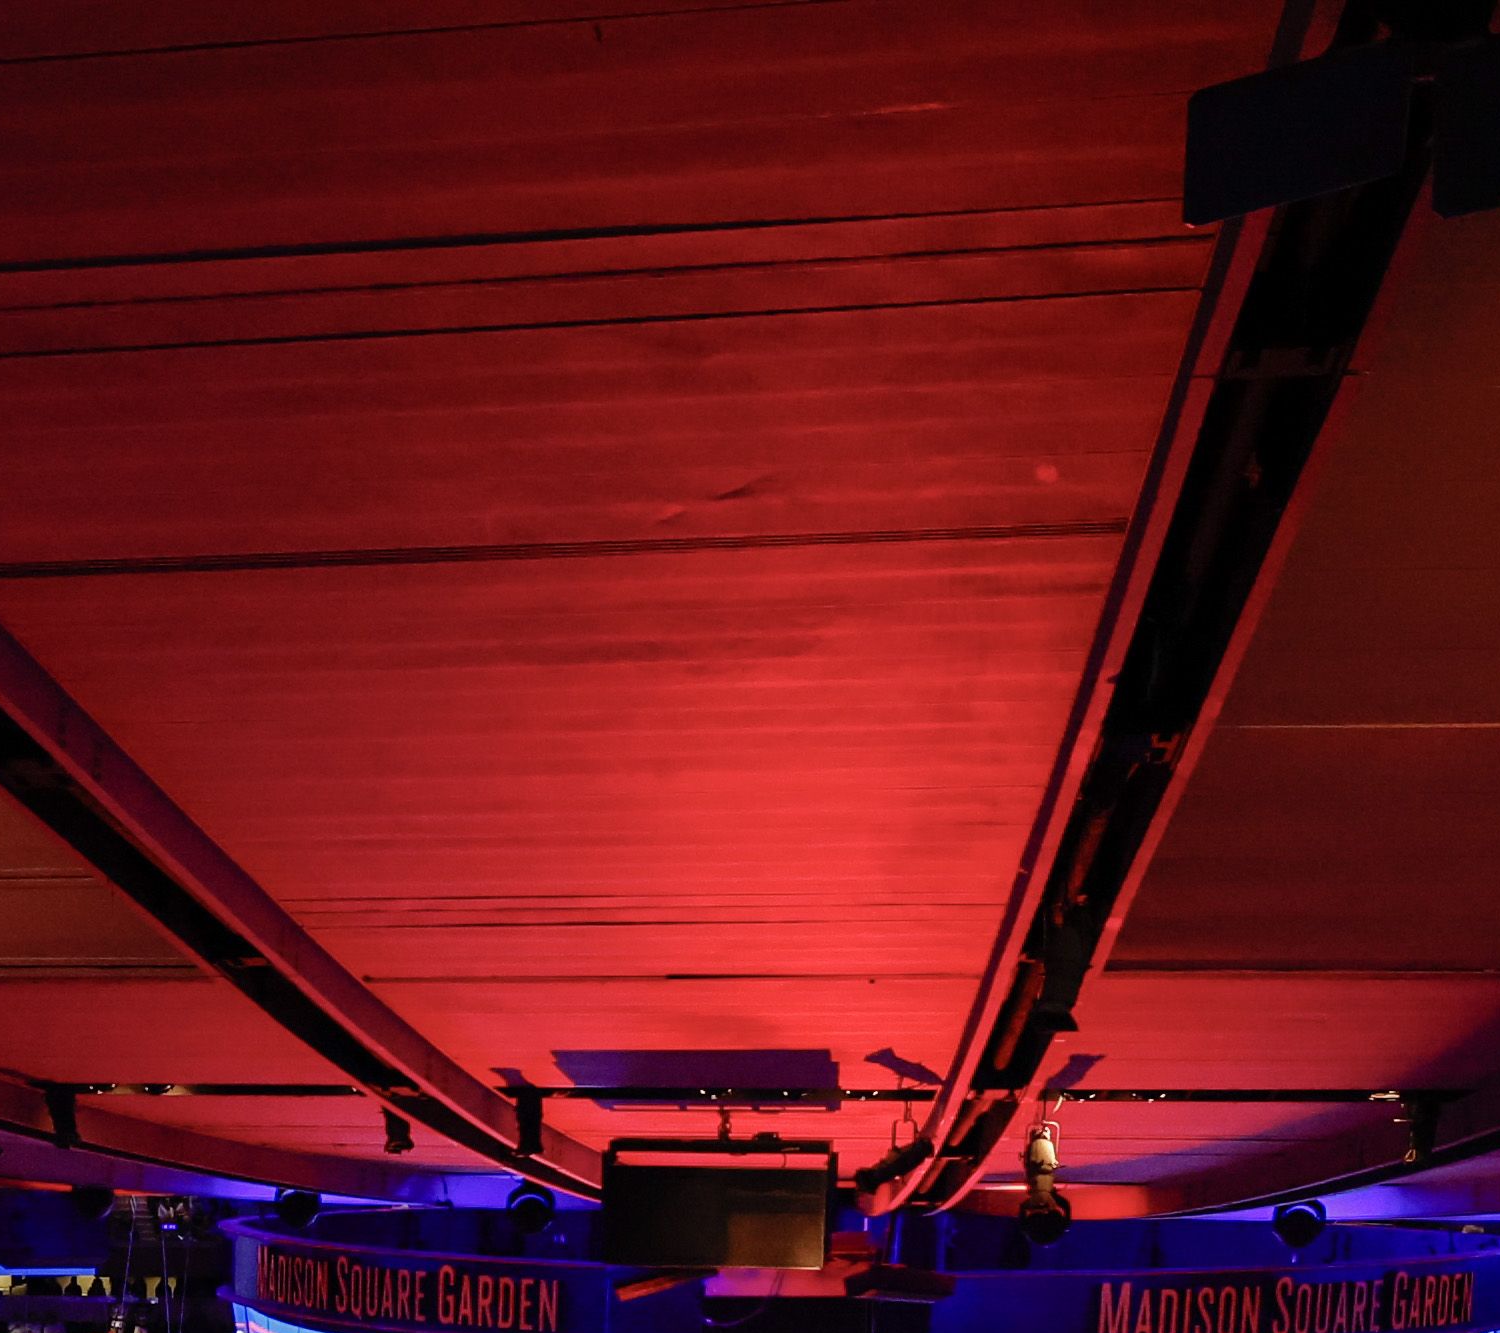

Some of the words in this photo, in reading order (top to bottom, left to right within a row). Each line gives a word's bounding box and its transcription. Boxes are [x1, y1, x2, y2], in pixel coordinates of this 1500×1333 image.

[256, 1245, 329, 1308] MADISON
[336, 1255, 427, 1322] SQUARE
[437, 1264, 559, 1333] GARDEN
[1391, 1271, 1475, 1329] GARDEN
